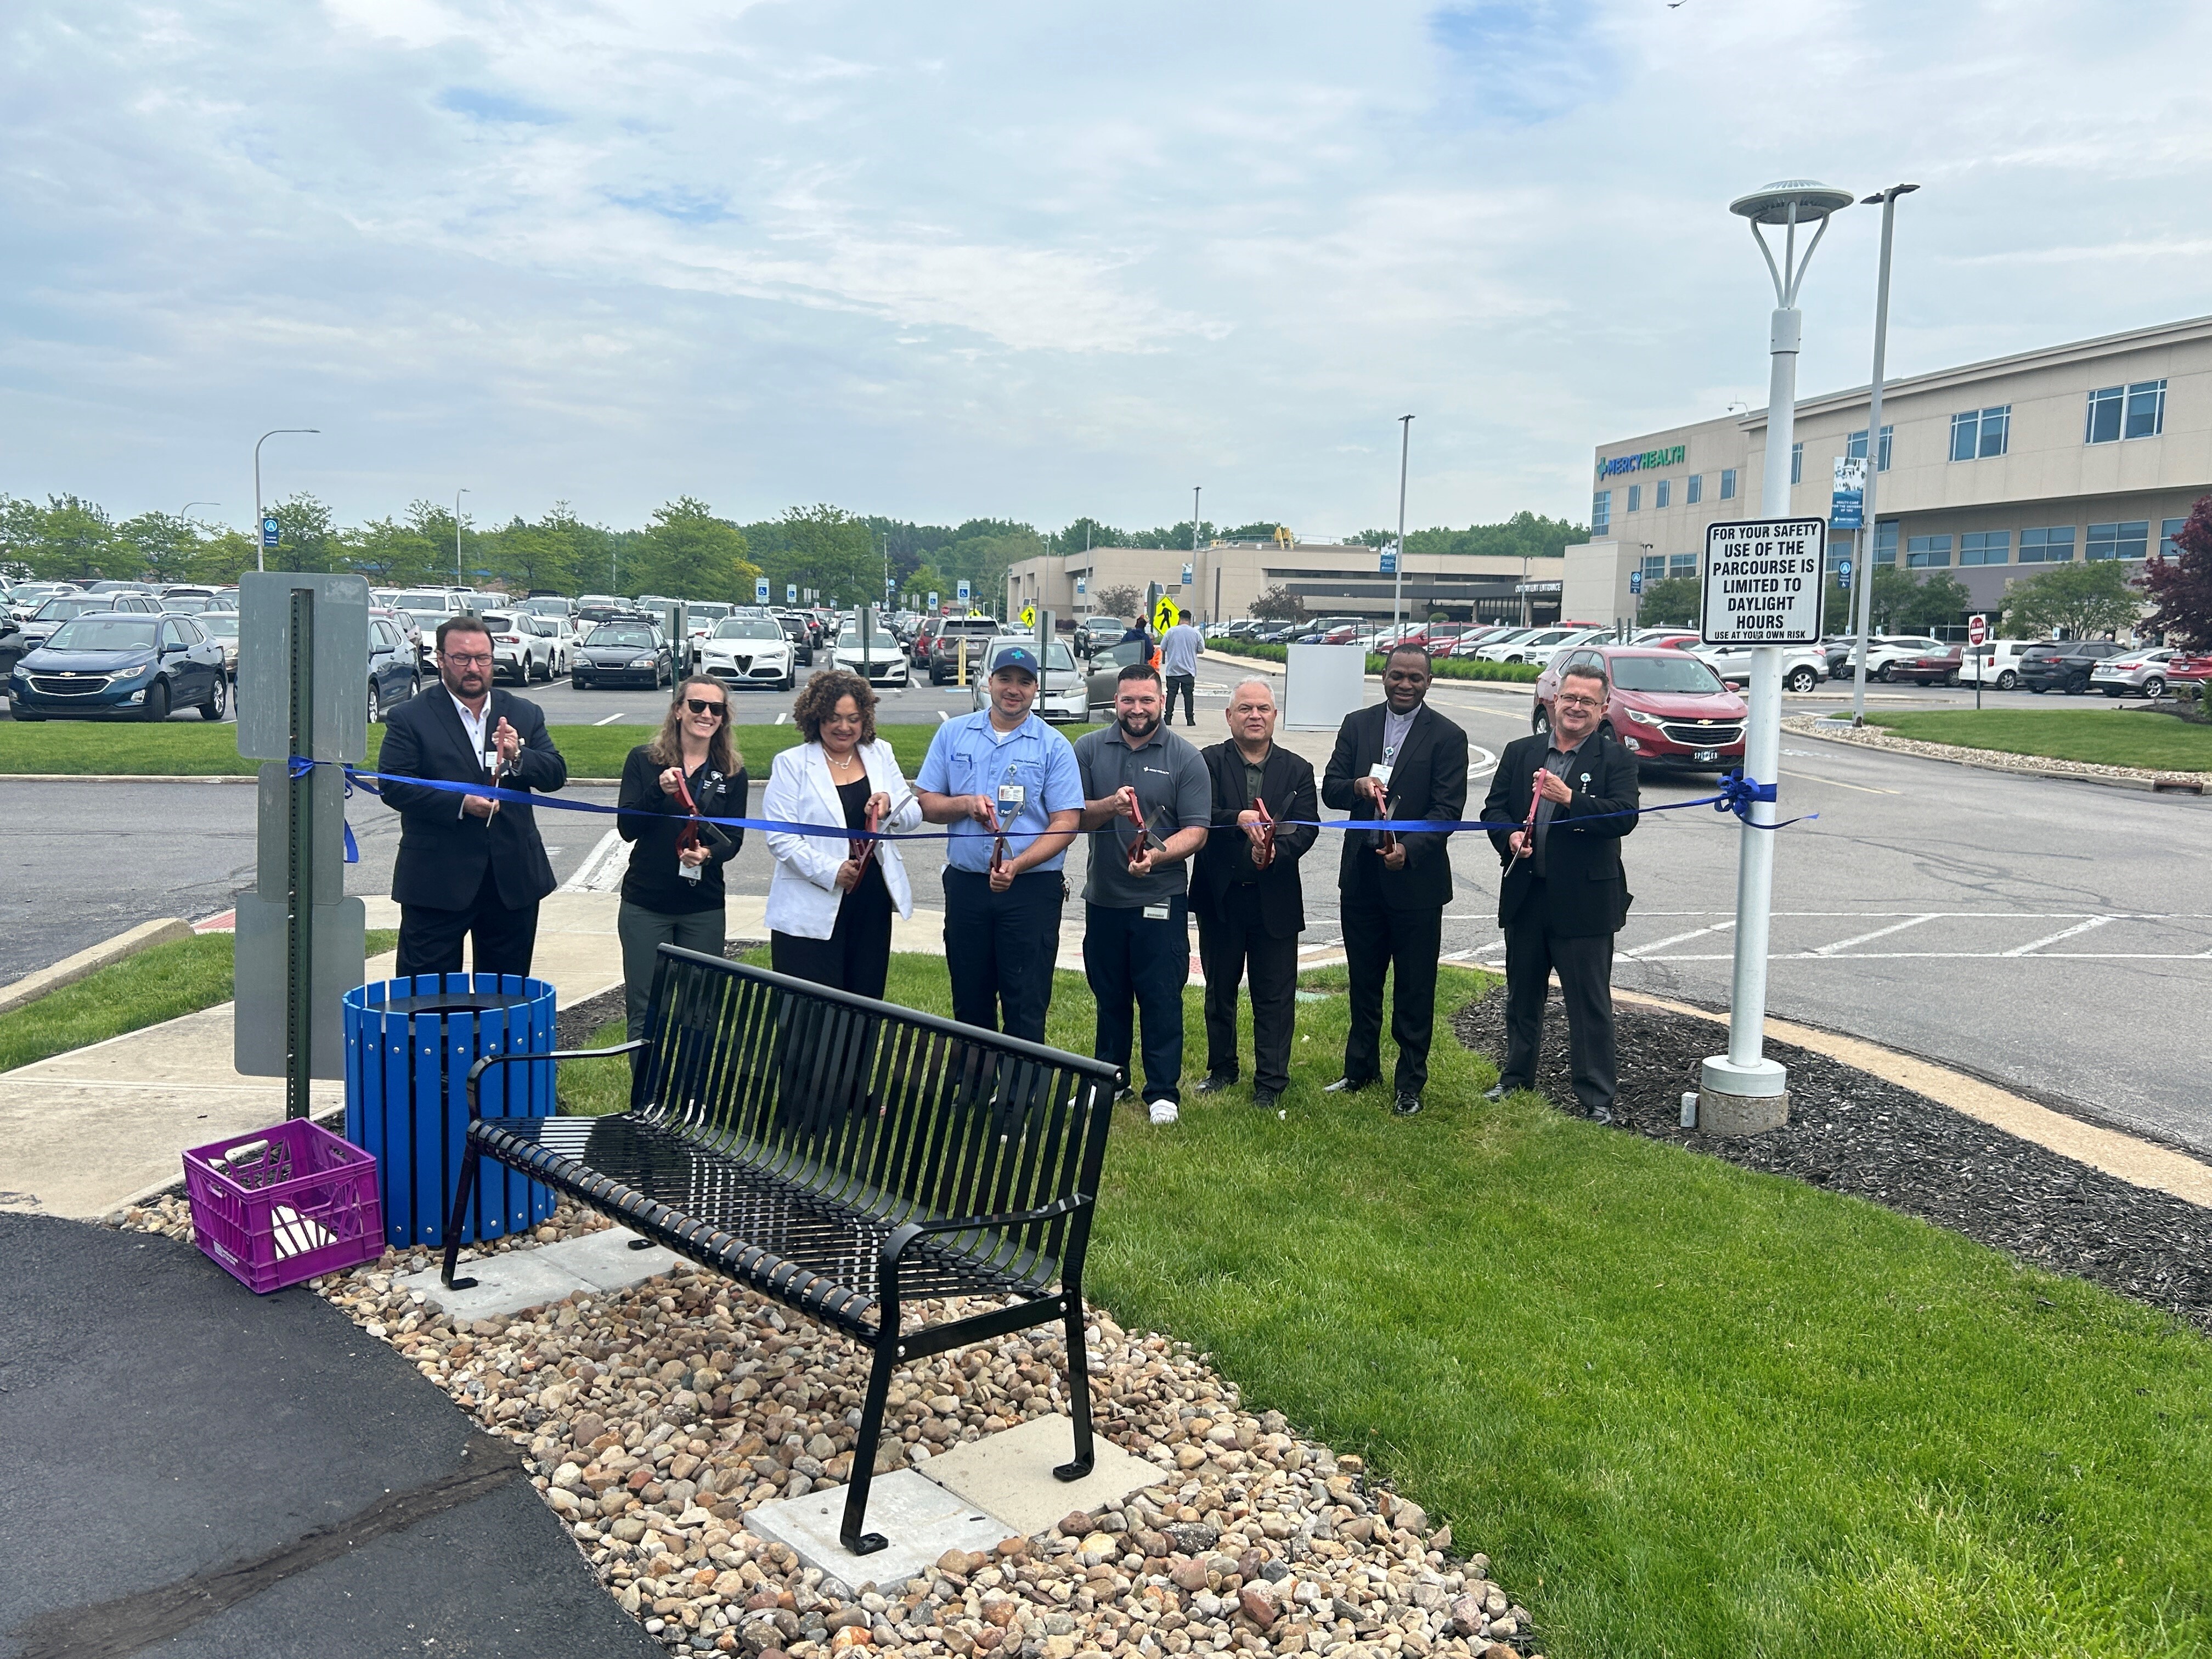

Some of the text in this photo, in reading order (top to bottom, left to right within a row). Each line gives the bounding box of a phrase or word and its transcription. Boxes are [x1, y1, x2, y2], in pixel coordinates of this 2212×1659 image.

[1713, 524, 1818, 540] FOR YOUR SAFETY
[1724, 540, 1804, 557] USE OF THE
[1713, 558, 1814, 575] PARCOURSE IS
[1723, 578, 1802, 594] LIMITED TO
[1728, 596, 1795, 611] DAYLIGHT
[1736, 614, 1784, 629] HOURS
[1743, 631, 1763, 639] YOUR
[1787, 630, 1805, 639] RISK
